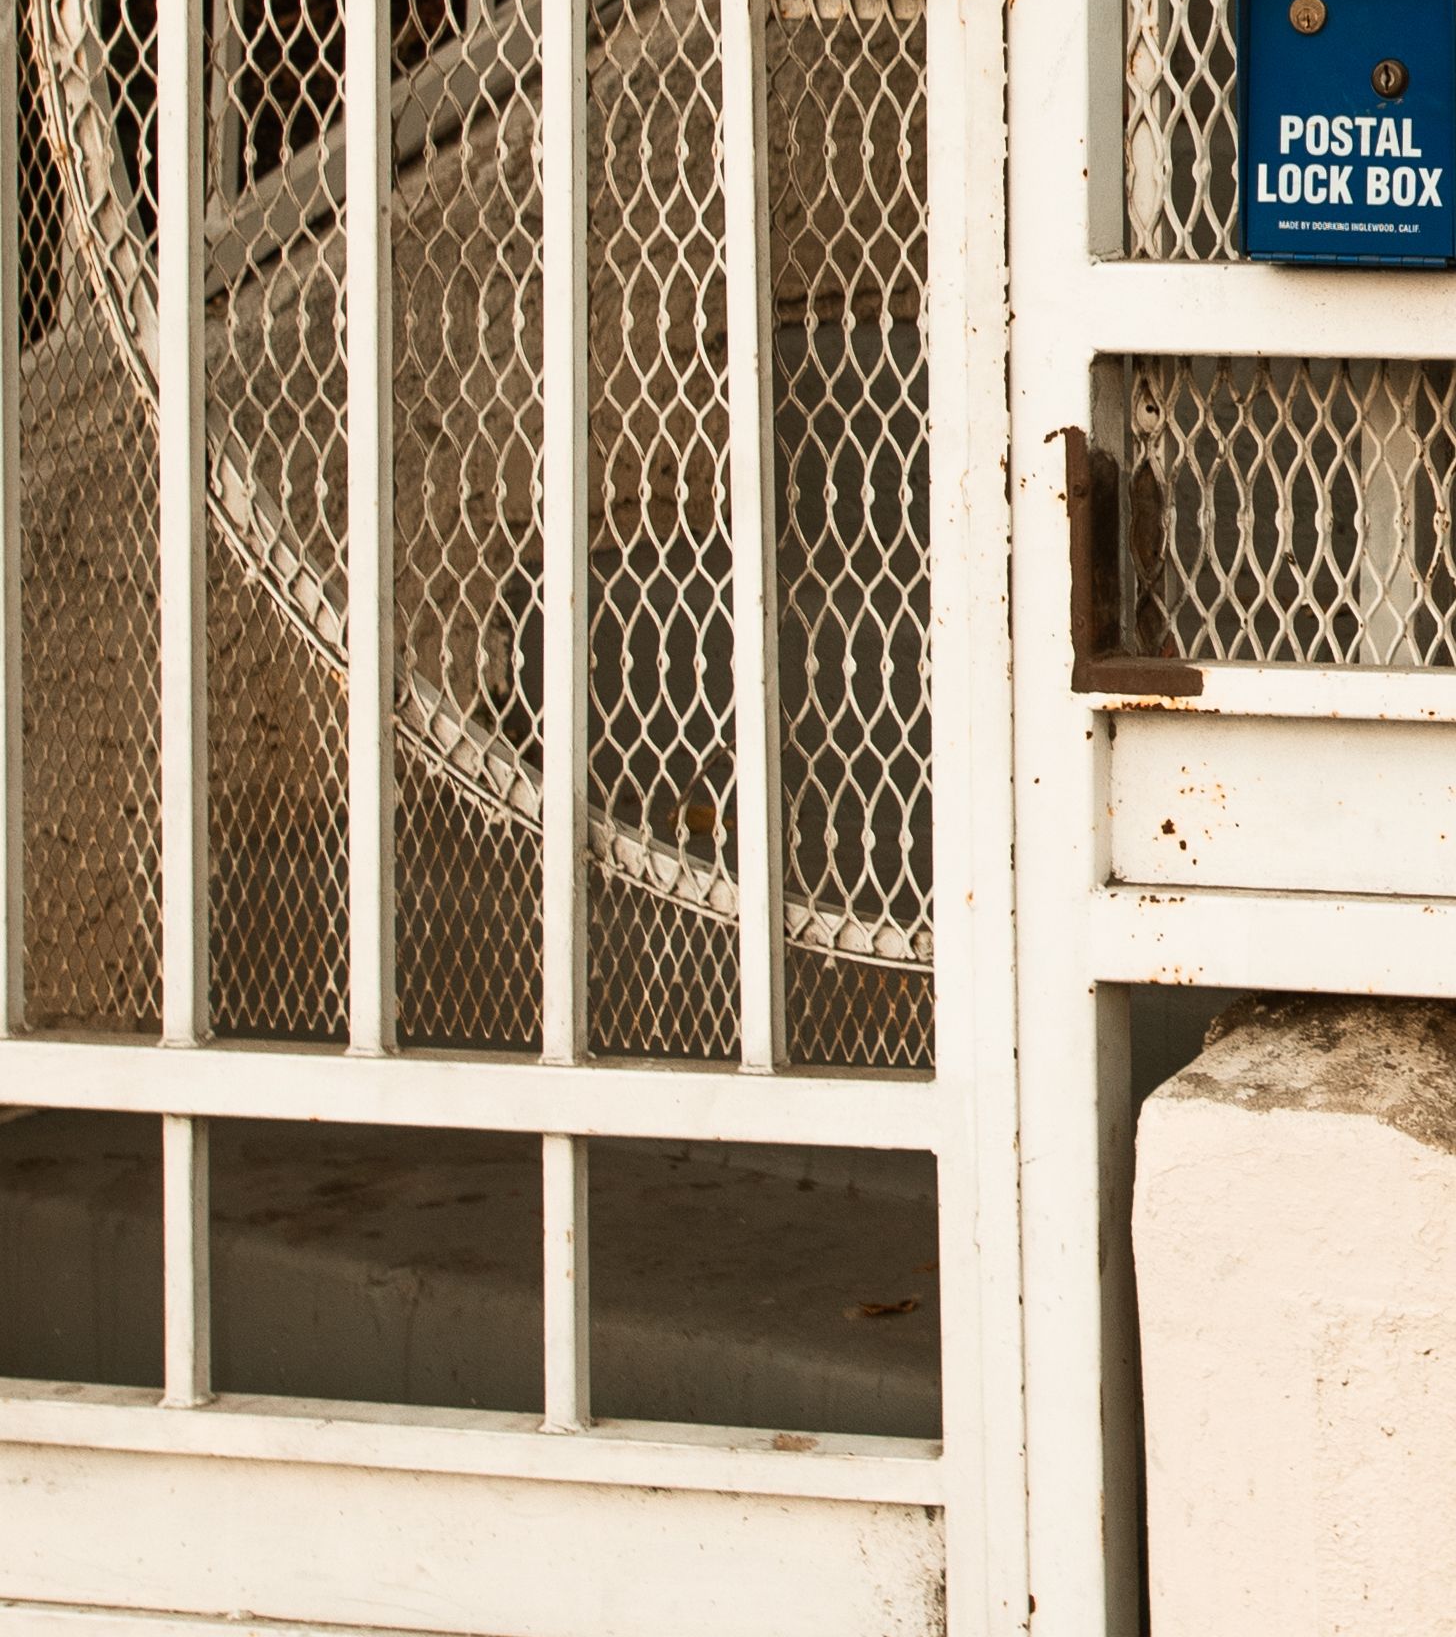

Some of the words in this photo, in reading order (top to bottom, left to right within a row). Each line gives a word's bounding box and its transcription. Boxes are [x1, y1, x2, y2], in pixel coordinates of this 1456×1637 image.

[1280, 115, 1422, 158] POSTAL
[1257, 163, 1353, 205] LOCK
[1366, 166, 1444, 208] BOX
[1278, 220, 1299, 230] MADE
[1301, 221, 1311, 230] BY
[1399, 224, 1421, 234] CALIF.
